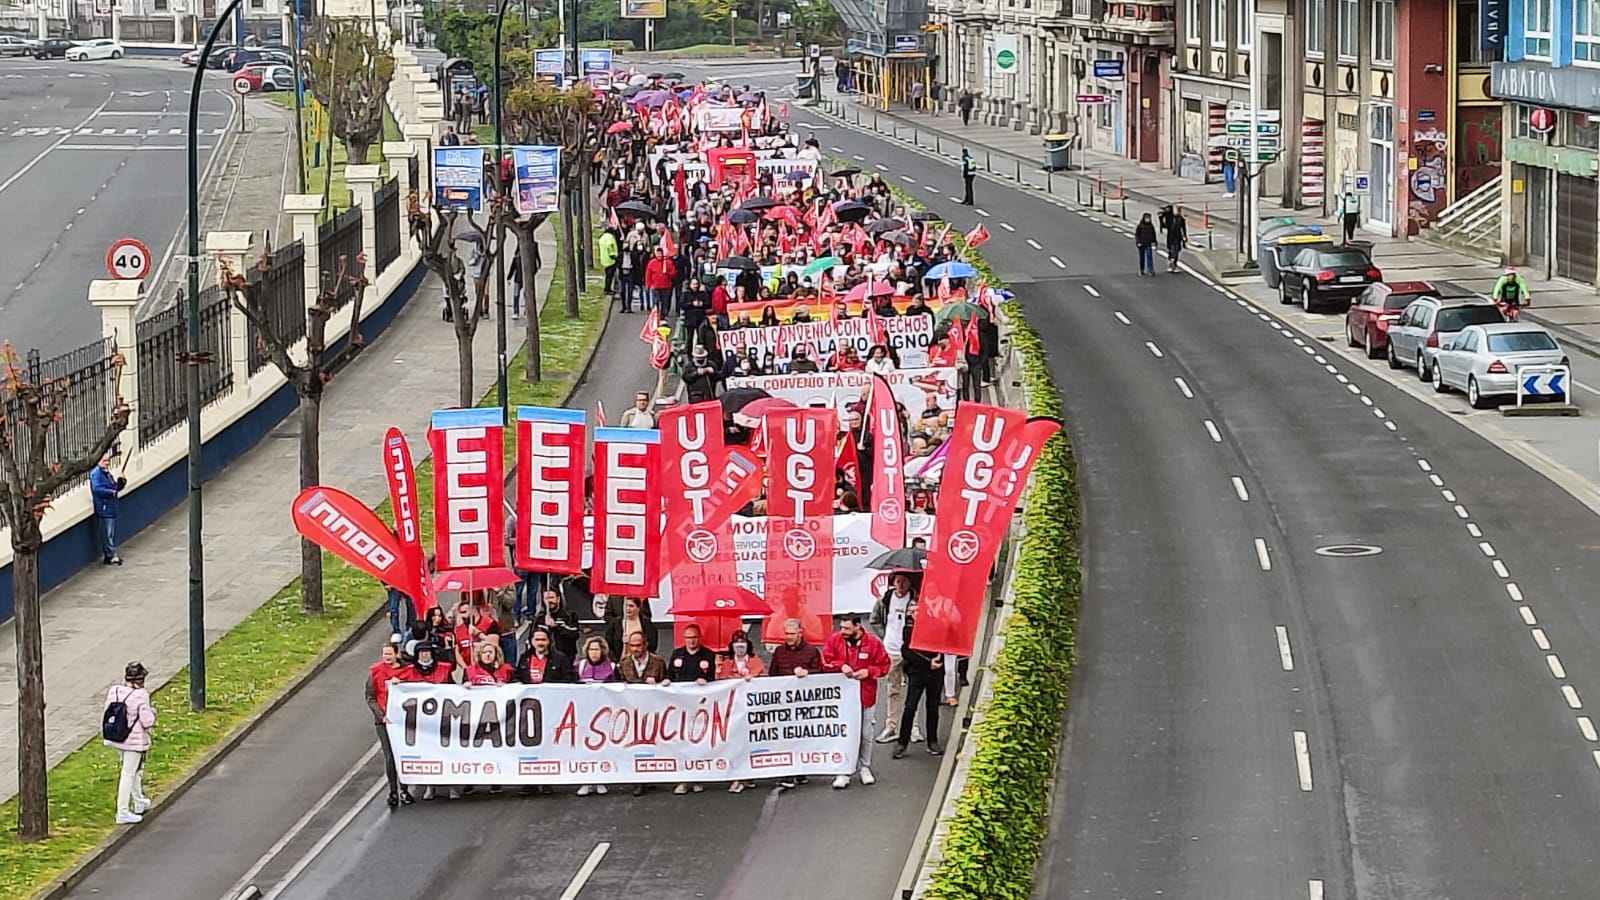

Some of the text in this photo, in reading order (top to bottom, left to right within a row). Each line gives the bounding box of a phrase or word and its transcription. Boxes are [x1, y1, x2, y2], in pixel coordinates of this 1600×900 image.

[115, 255, 141, 269] 40
[771, 320, 833, 343] CONVENIO
[838, 317, 861, 336] CON
[763, 376, 824, 391] CONVENIO
[677, 412, 711, 525] UGT
[785, 417, 816, 525] UGT
[960, 413, 1005, 527] UGT
[446, 428, 490, 568] CCOO
[530, 421, 570, 561] CCOO
[605, 443, 647, 585] CCOO
[728, 572, 754, 584] LOS
[747, 686, 841, 706] SUBIR SALARIOS
[553, 701, 577, 748] A
[584, 688, 736, 750] SOLUCIÓN
[748, 705, 839, 724] CONTER PREZOS
[783, 724, 847, 739] IGUALDADE
[569, 762, 597, 773] UGT
[684, 760, 712, 771] UGT
[800, 752, 829, 764] UGT
[452, 763, 481, 774] UGT
